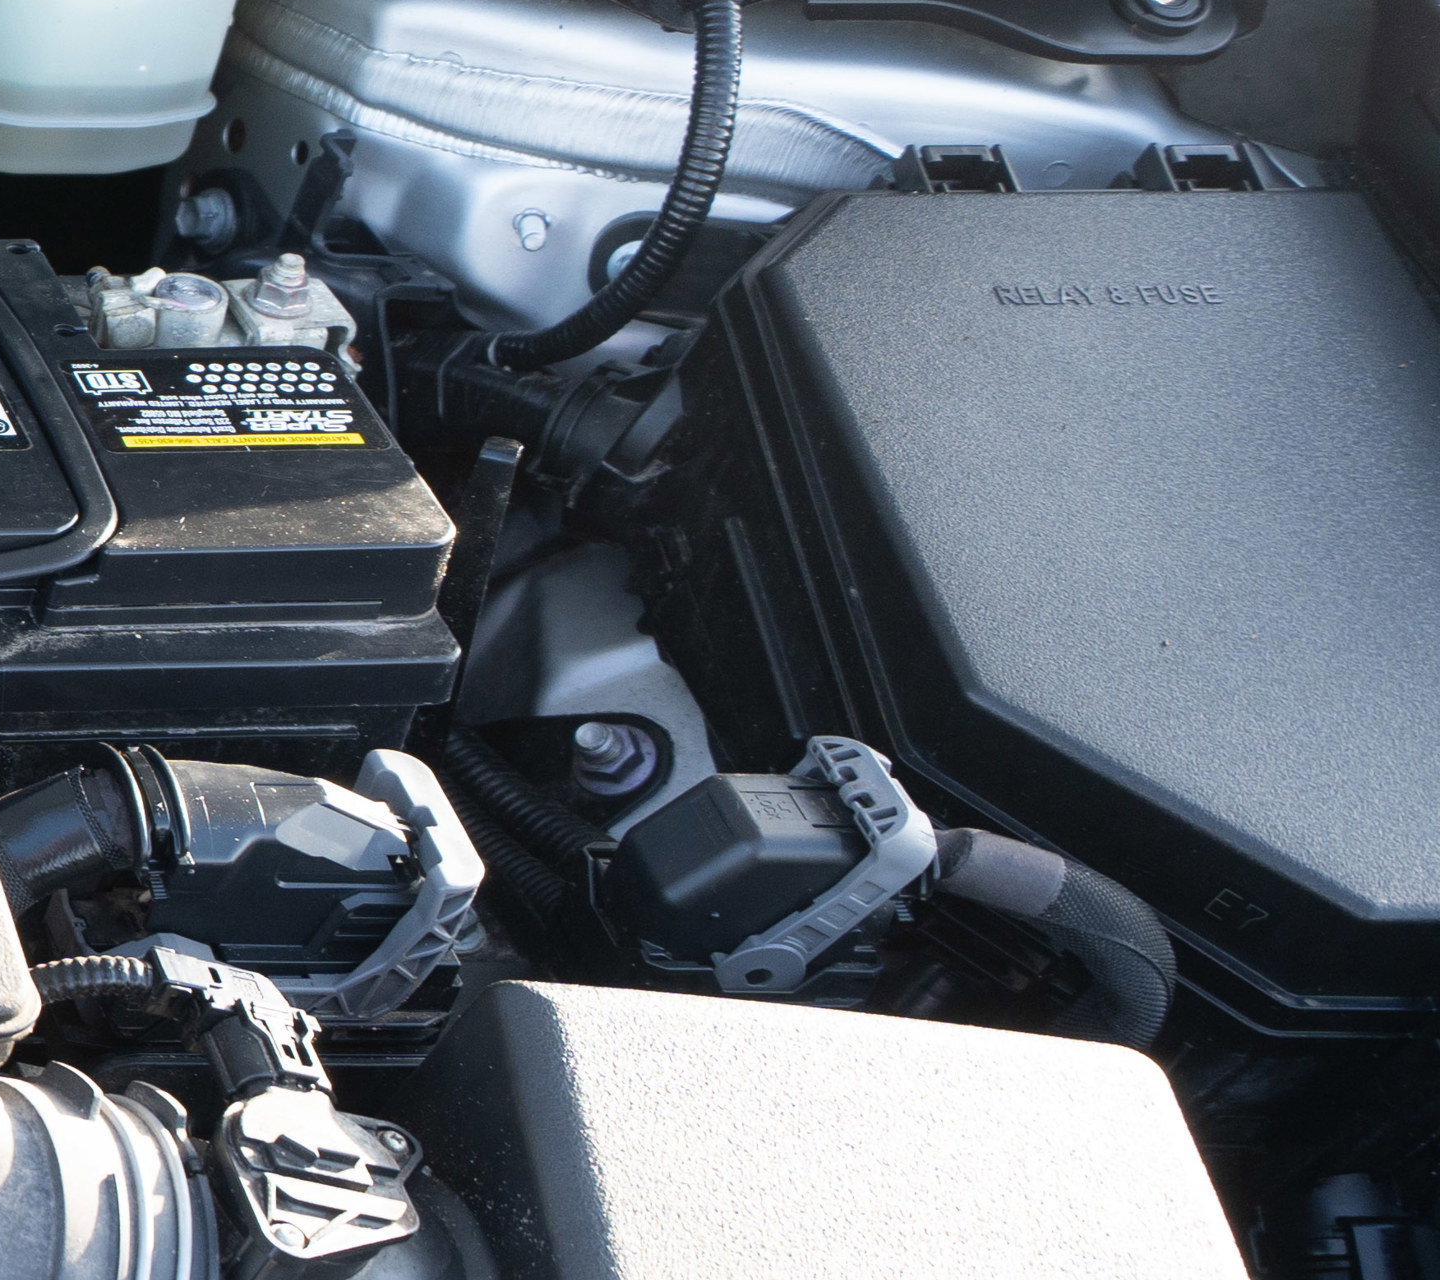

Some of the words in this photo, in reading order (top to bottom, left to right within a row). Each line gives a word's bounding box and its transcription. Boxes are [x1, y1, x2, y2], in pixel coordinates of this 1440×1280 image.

[993, 285, 1094, 305] RELAY
[1106, 285, 1130, 305] &
[1137, 284, 1224, 305] FUSE
[85, 373, 141, 389] STD
[245, 410, 353, 423] START
[249, 421, 347, 432] SUPER
